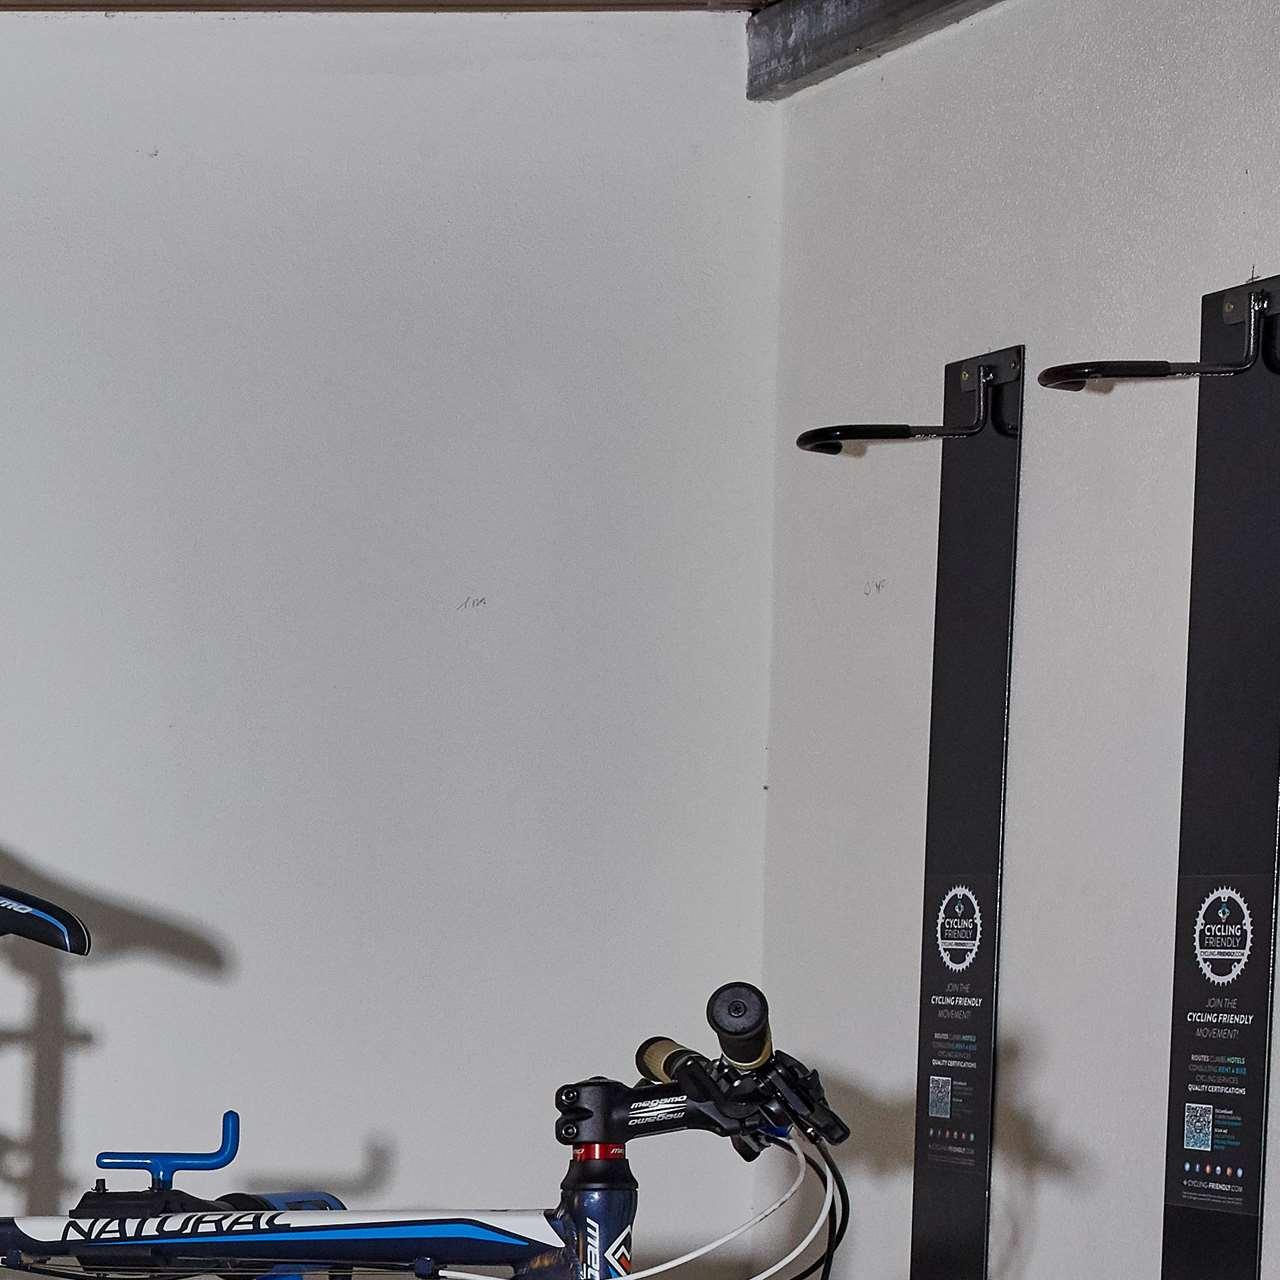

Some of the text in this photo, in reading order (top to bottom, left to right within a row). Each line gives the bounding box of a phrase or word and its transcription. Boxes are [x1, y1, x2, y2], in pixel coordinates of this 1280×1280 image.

[945, 918, 973, 928] CYCLING
[944, 929, 973, 939] FRIENDLY
[1204, 924, 1241, 936] CYCLING
[1204, 936, 1241, 948] FRIENDLY
[931, 995, 982, 1007] CYCLING FRIENDLY
[1187, 1012, 1254, 1025] CYCLING FRIENDLY
[1188, 1084, 1208, 1093] QUALITY
[630, 1095, 688, 1109] megamo
[61, 1211, 290, 1242] NATURAL
